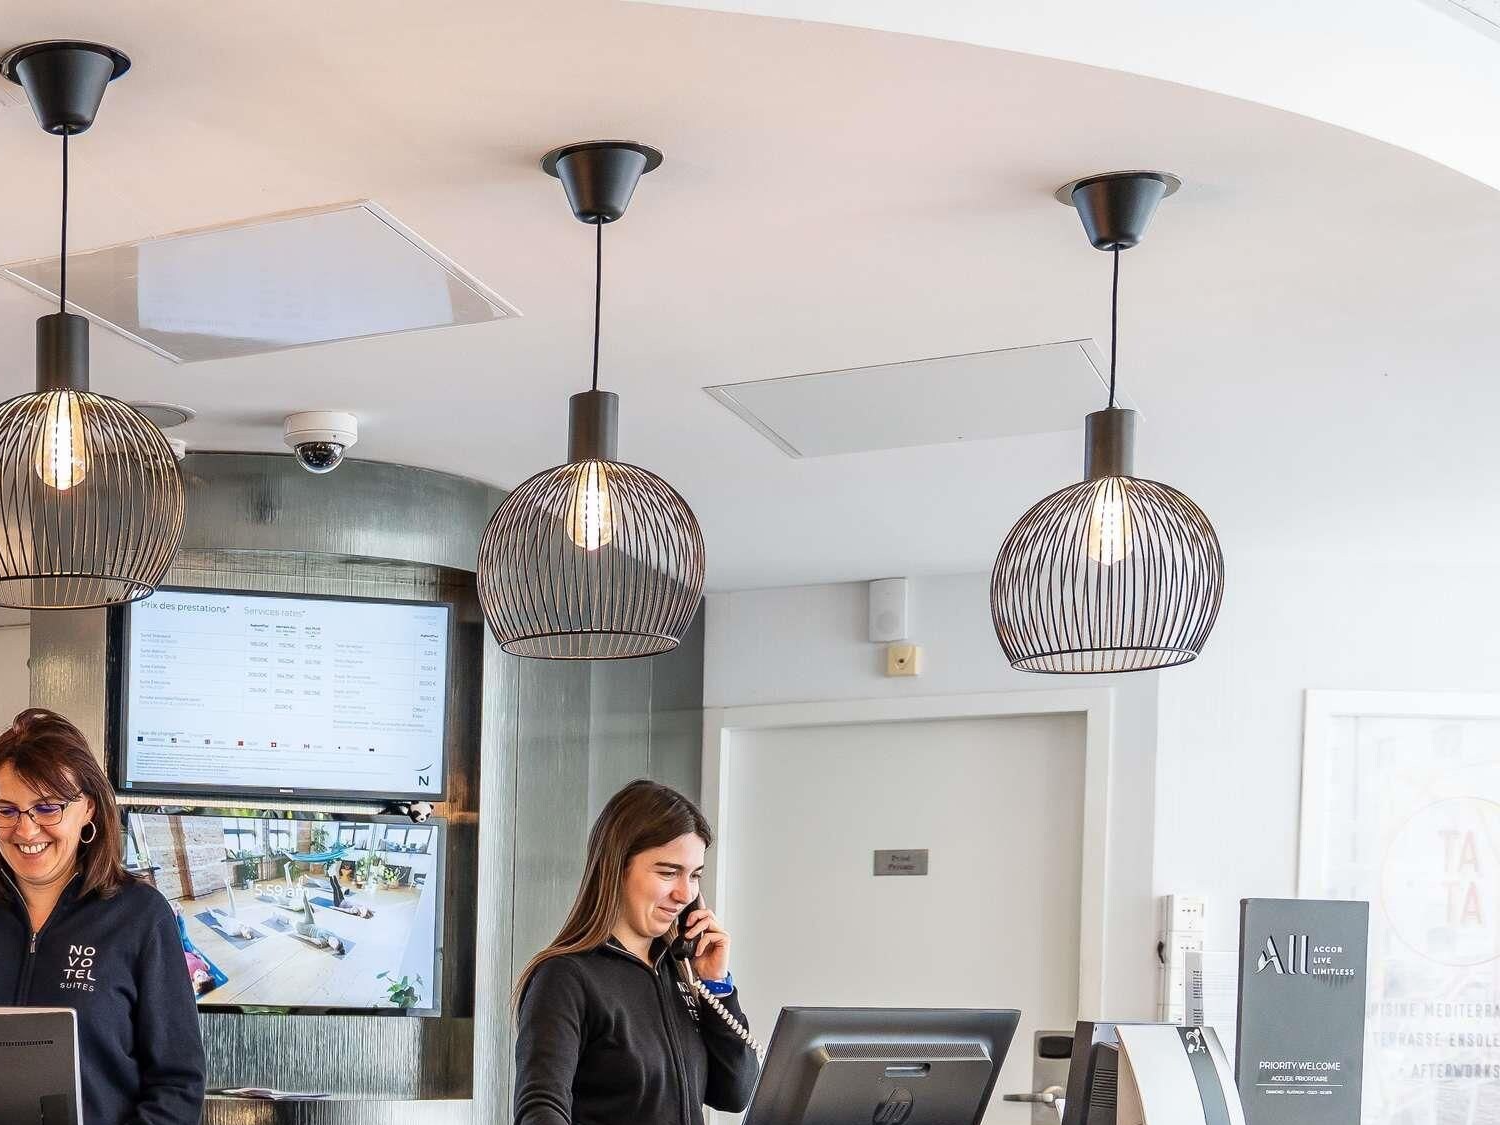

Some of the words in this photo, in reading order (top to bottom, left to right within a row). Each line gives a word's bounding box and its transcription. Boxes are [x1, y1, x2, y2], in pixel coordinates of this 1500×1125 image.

[141, 600, 158, 609] Prix
[159, 602, 175, 611] des
[244, 606, 280, 617] Services
[418, 775, 430, 786] N
[1438, 829, 1481, 874] TA
[1440, 881, 1483, 925] TA
[69, 945, 96, 956] NO
[1256, 934, 1309, 975] All
[68, 956, 93, 968] VO
[63, 969, 97, 981] TEL
[1313, 968, 1355, 976] LIMITLESS
[60, 982, 95, 992] SUITES
[1366, 1002, 1417, 1017] UISINE
[1372, 1032, 1444, 1048] TERRASSE
[1259, 1061, 1297, 1070] PRIORITY
[1299, 1062, 1341, 1071] WELCOME
[1411, 1063, 1500, 1079] AFTERWORKS
